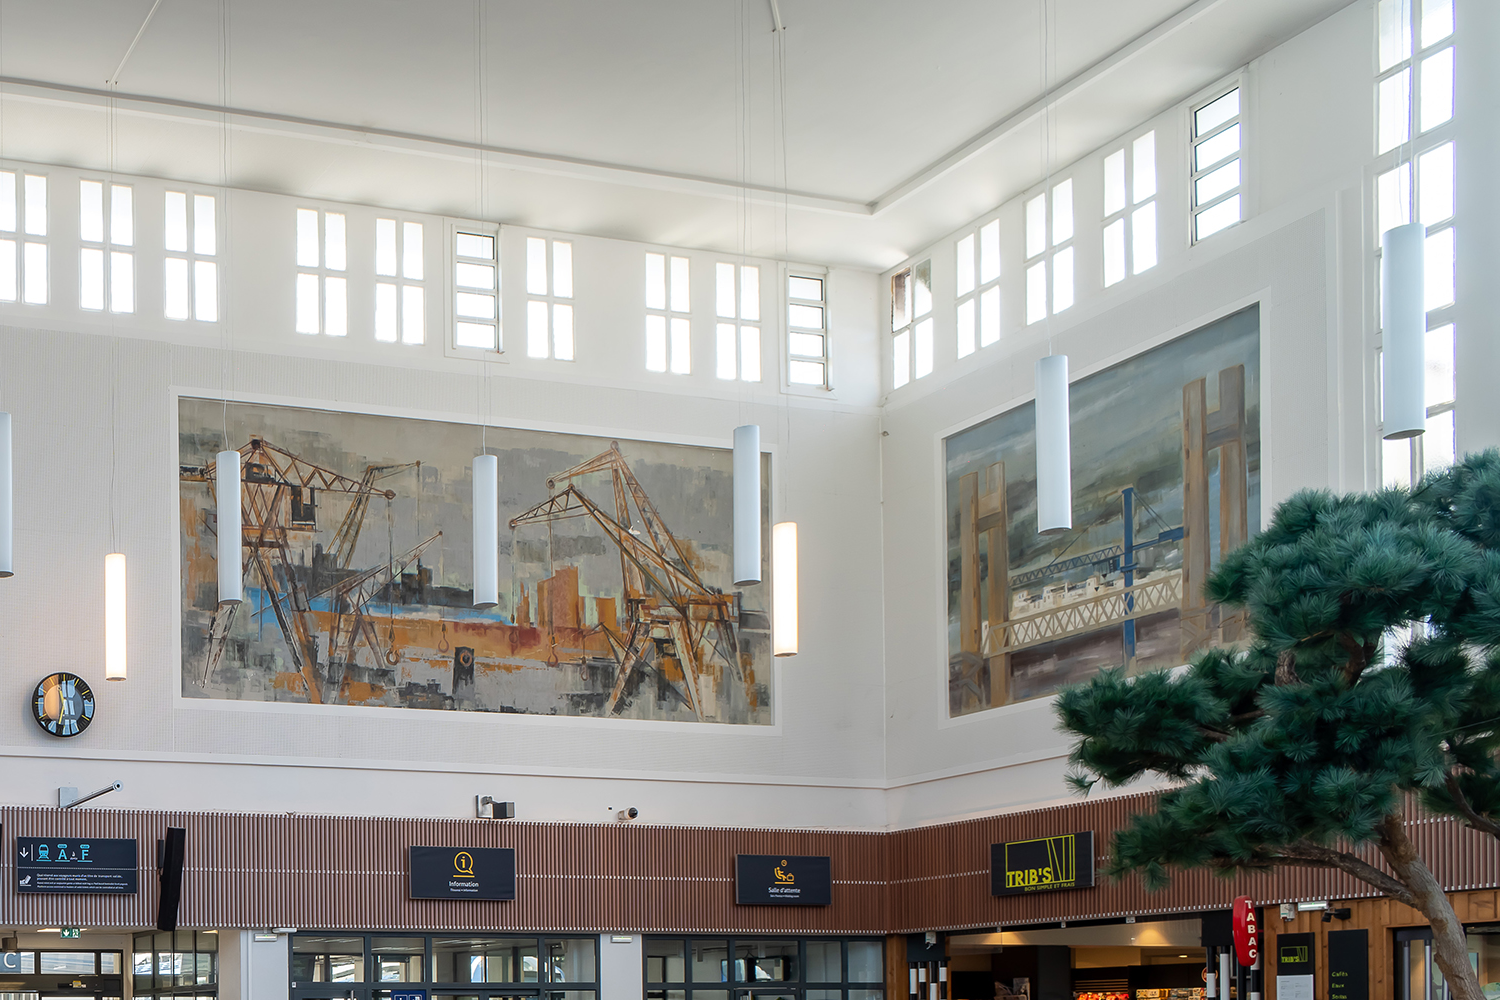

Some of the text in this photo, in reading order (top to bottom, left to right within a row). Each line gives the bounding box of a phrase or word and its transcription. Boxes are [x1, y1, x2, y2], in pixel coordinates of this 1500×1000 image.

[58, 849, 89, 860] A F
[1006, 867, 1052, 887] TRIB'S
[1245, 900, 1257, 959] TABAC
[3, 952, 17, 968] C
